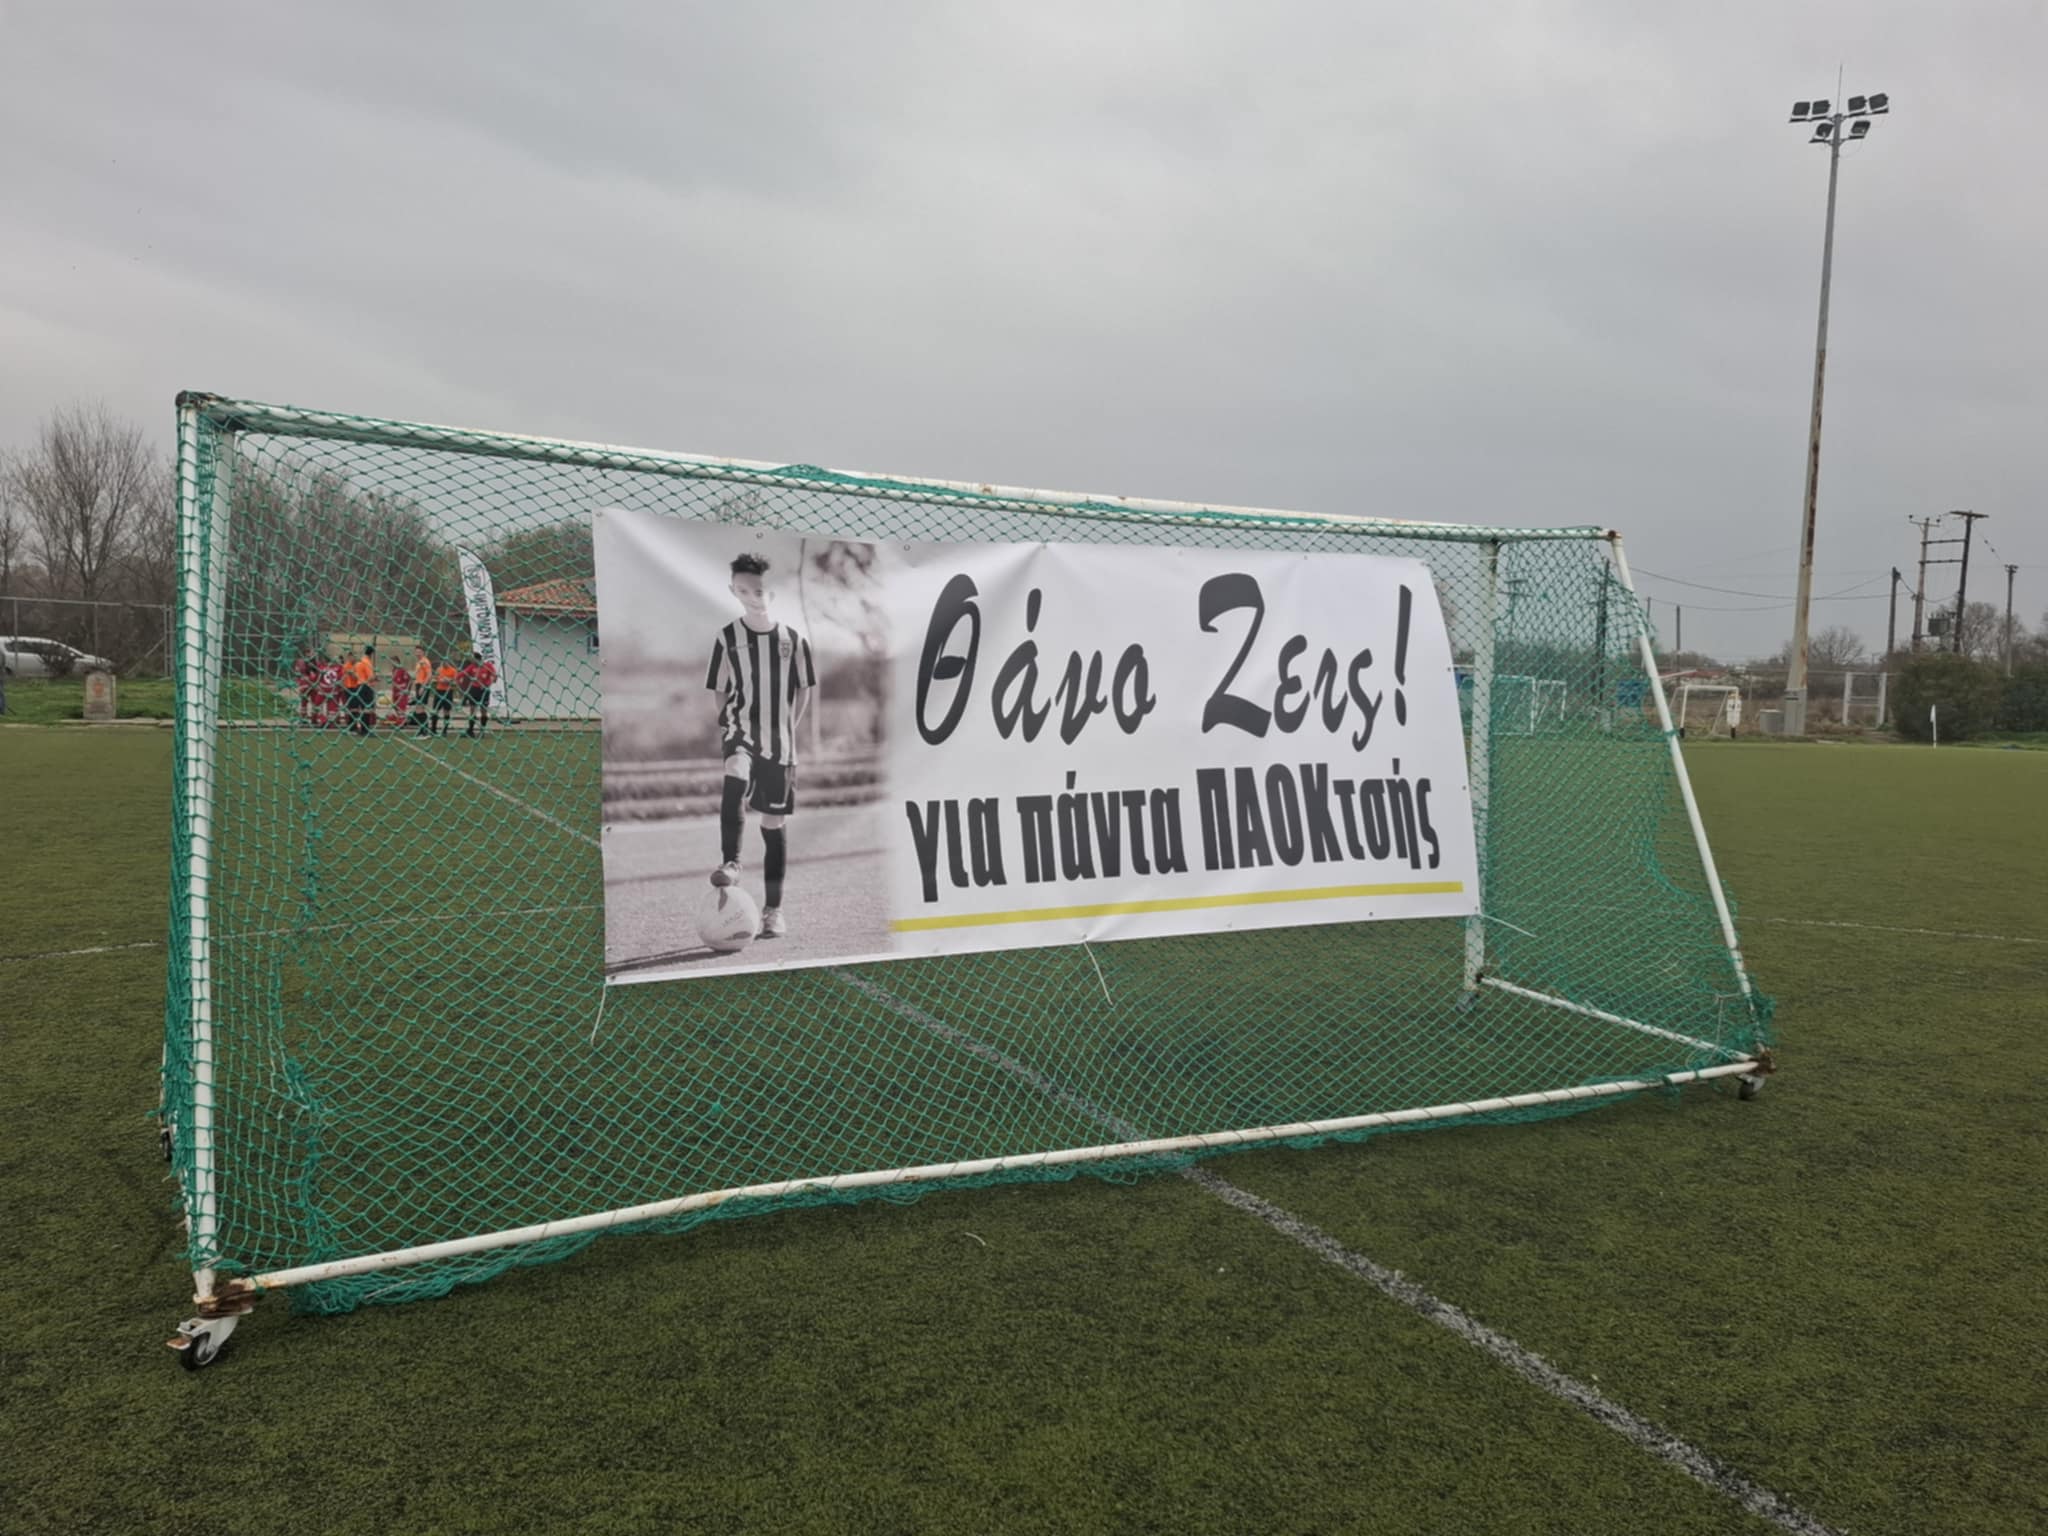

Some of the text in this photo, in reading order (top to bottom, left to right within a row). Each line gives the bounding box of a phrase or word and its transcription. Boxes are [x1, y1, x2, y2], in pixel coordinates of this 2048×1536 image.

[915, 572, 1412, 752] Θάνο Ζεις!
[905, 757, 1441, 903] για πάντα ΠΑΟΚτσής
